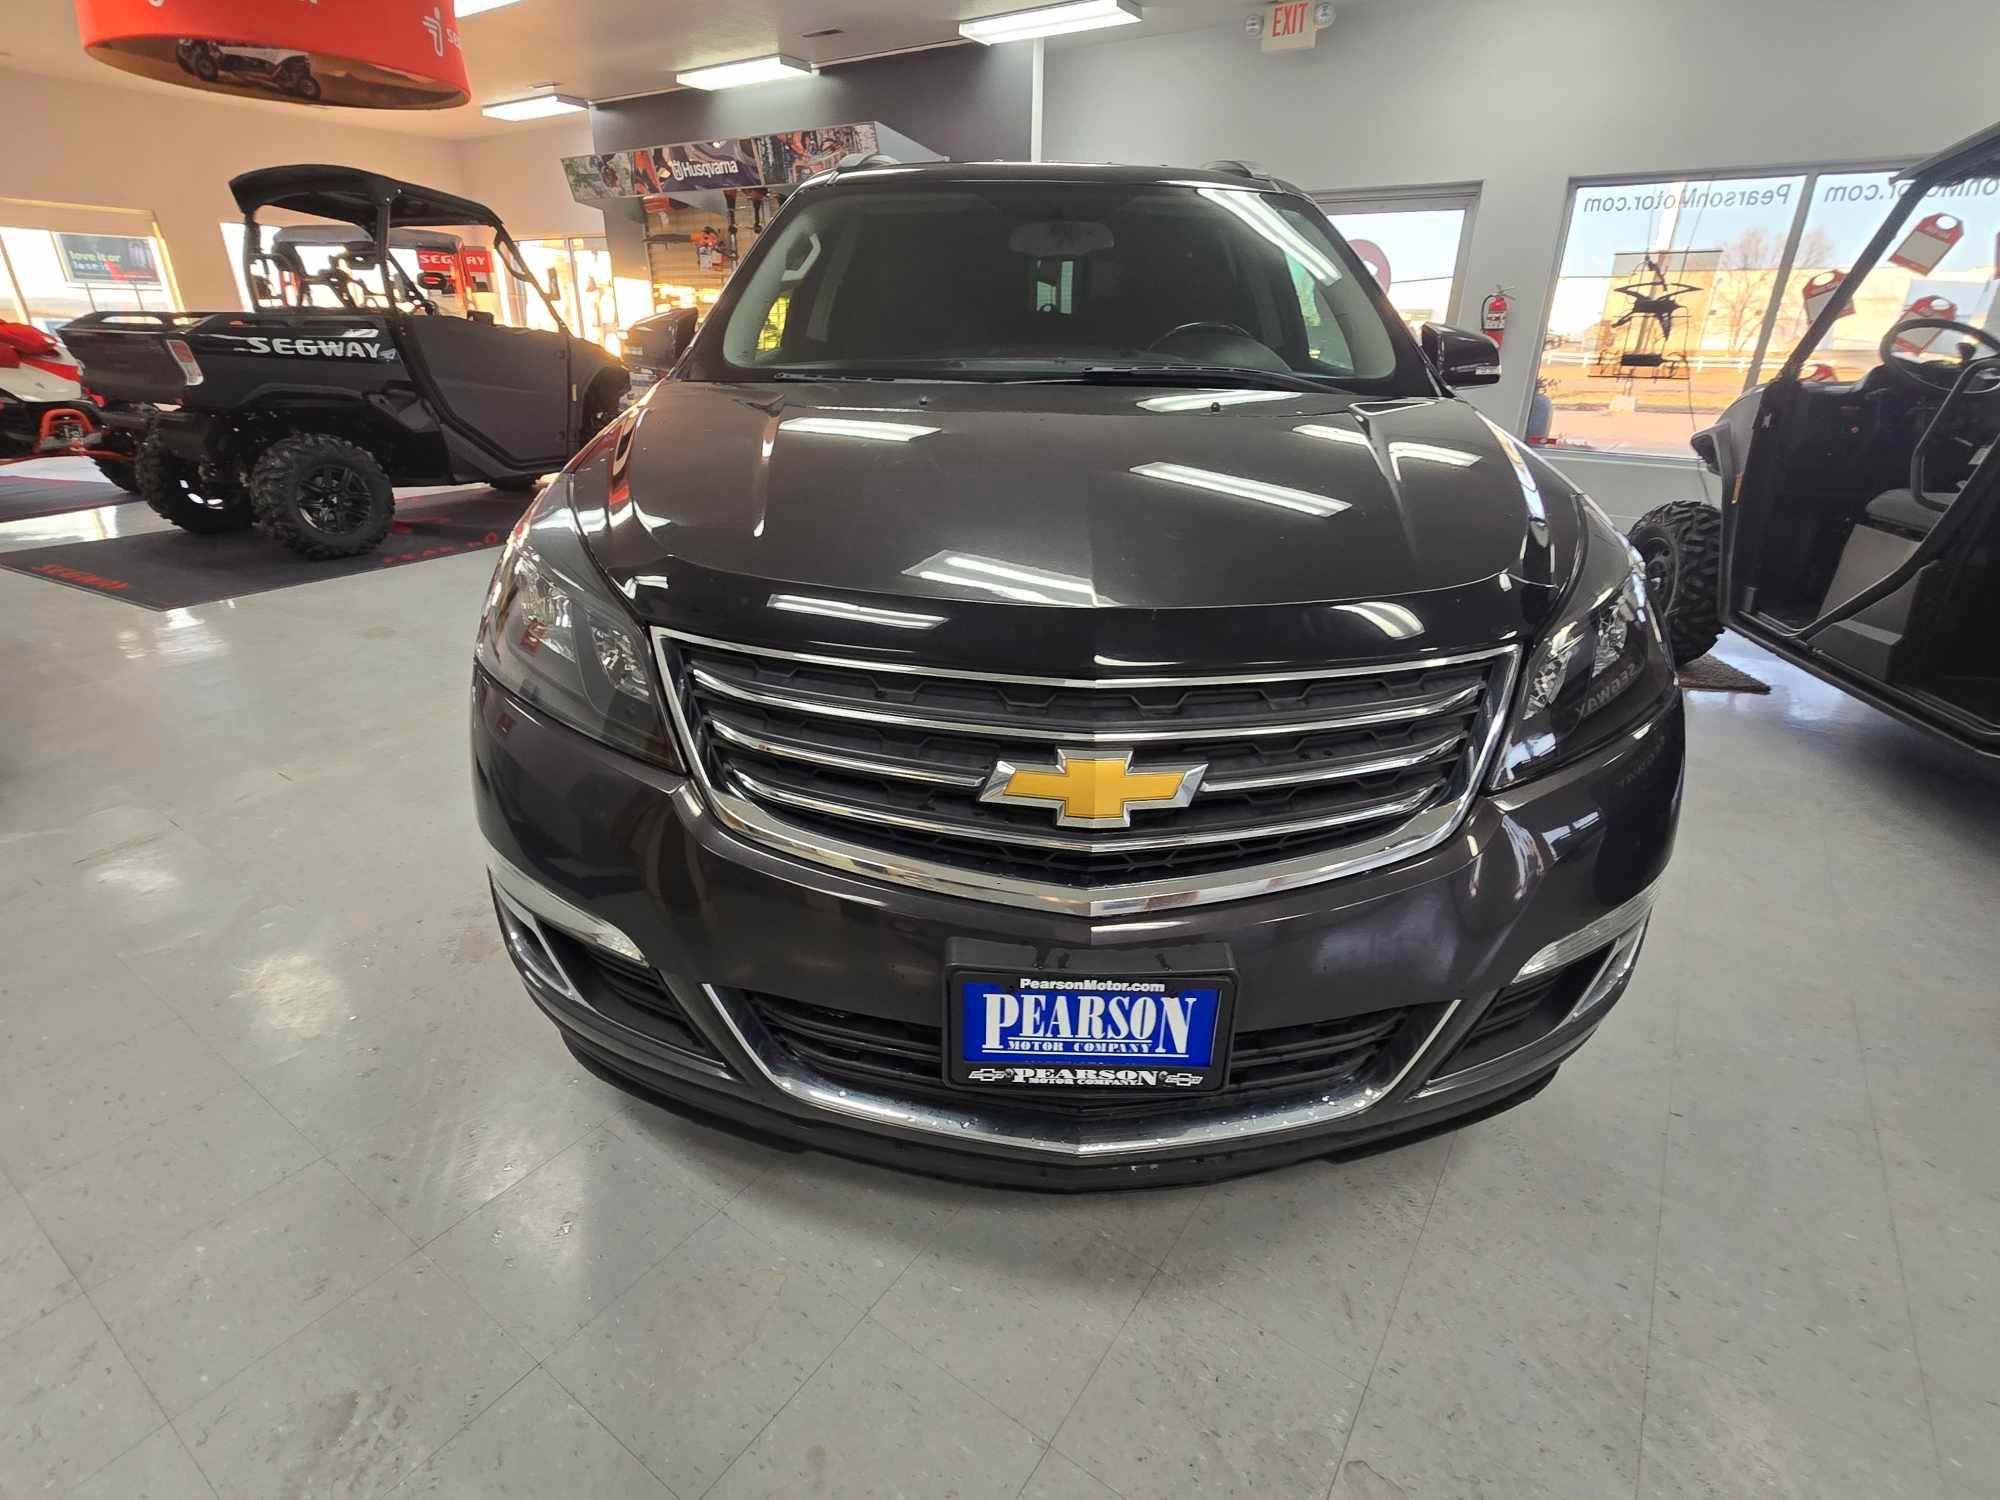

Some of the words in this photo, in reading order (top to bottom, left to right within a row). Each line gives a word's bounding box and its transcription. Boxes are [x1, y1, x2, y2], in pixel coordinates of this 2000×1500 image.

[1272, 2, 1309, 37] EXIT
[681, 160, 740, 178] Husqvarna
[419, 254, 486, 265] SEGAY
[242, 337, 381, 358] SEGWAY
[1020, 978, 1165, 992] PearsonMotor.com
[982, 993, 1197, 1054] PEARSON
[1008, 1040, 1064, 1051] MOTOR
[1073, 1042, 1152, 1053] COMPANY
[1012, 1067, 1159, 1086] PEARSON
[1029, 1077, 1075, 1085] MOTOR
[1077, 1078, 1140, 1086] COMPANY
